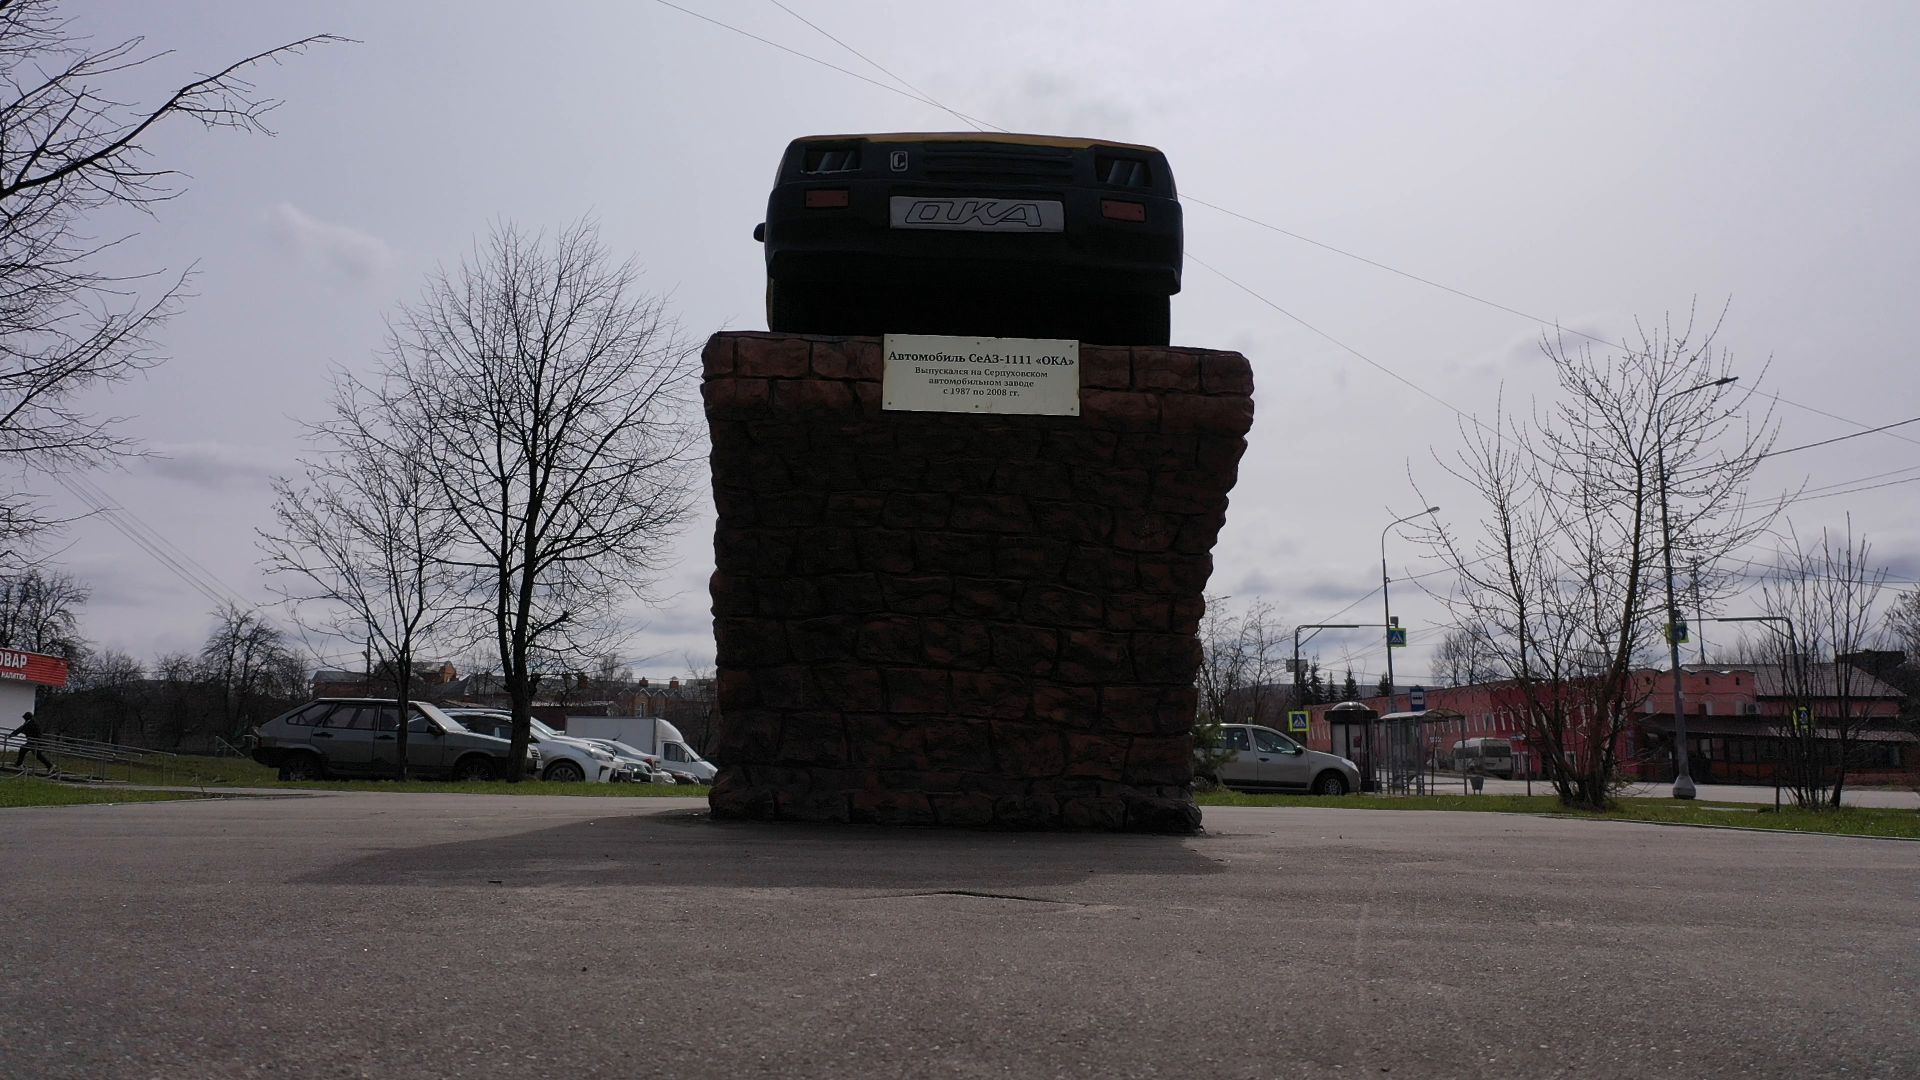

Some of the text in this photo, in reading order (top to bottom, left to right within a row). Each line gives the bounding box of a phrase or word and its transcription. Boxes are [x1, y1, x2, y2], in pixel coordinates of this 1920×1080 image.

[888, 351, 1075, 366] Автомобиль СеАЗ-1111 «ОКА»
[915, 366, 969, 376] Выпускался
[984, 369, 1048, 379] Серпуховском
[928, 377, 1034, 388] автомобильном заводе
[951, 387, 970, 396] 1987
[986, 388, 1007, 397] 2008
